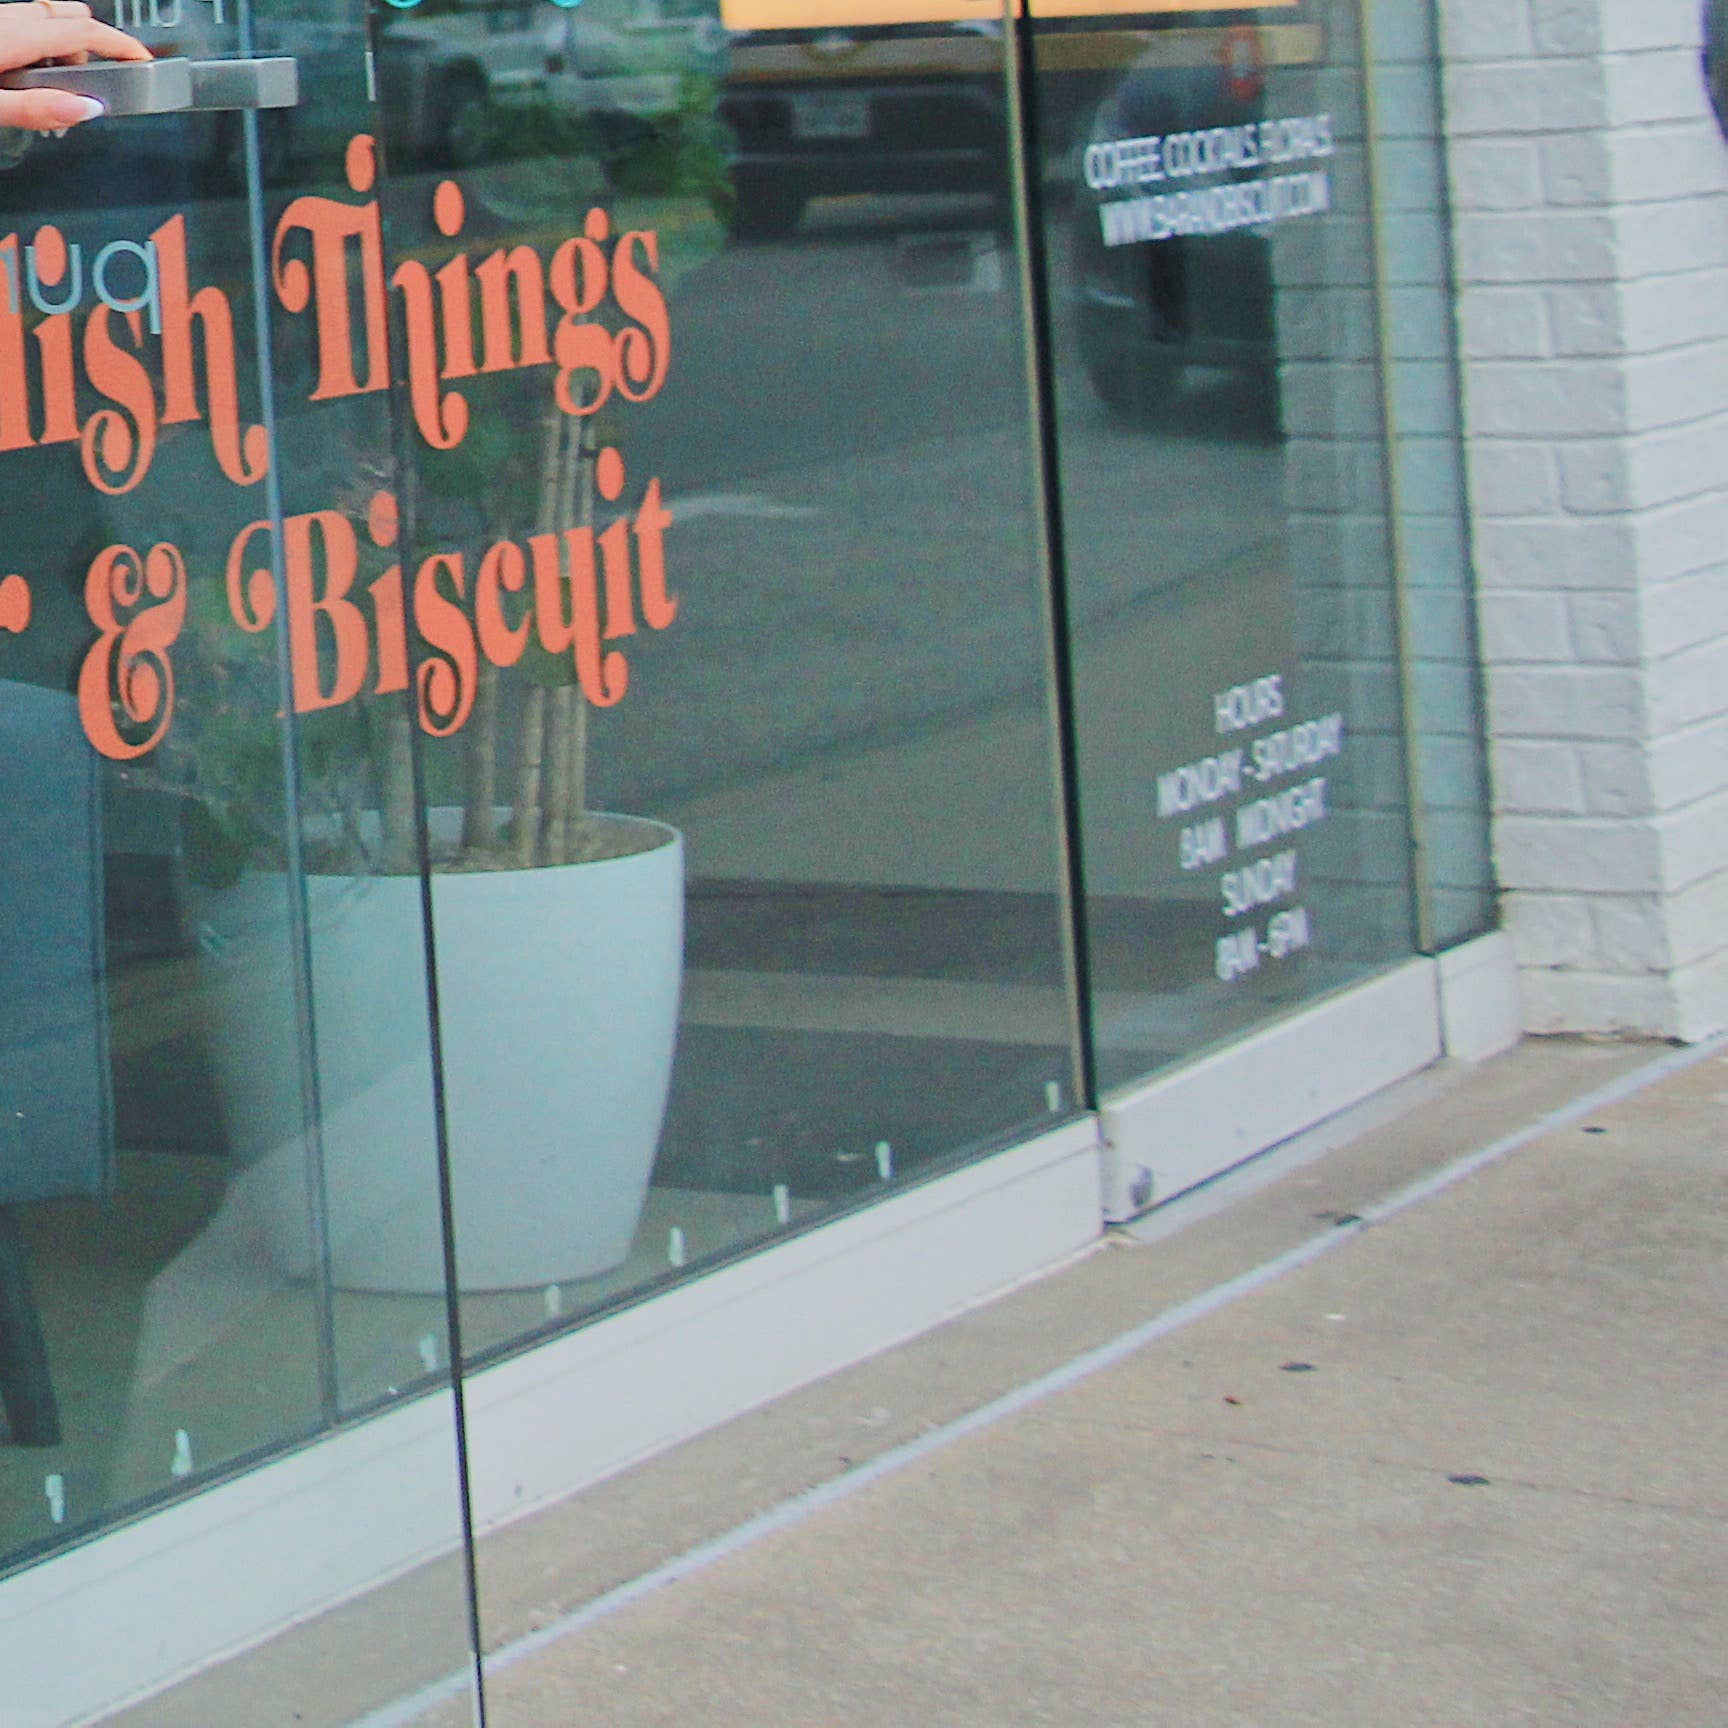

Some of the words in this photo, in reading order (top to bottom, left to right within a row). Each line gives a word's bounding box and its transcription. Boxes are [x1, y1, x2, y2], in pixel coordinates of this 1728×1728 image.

[275, 134, 672, 450] Things
[79, 542, 187, 761] &
[226, 450, 678, 737] Biscuit
